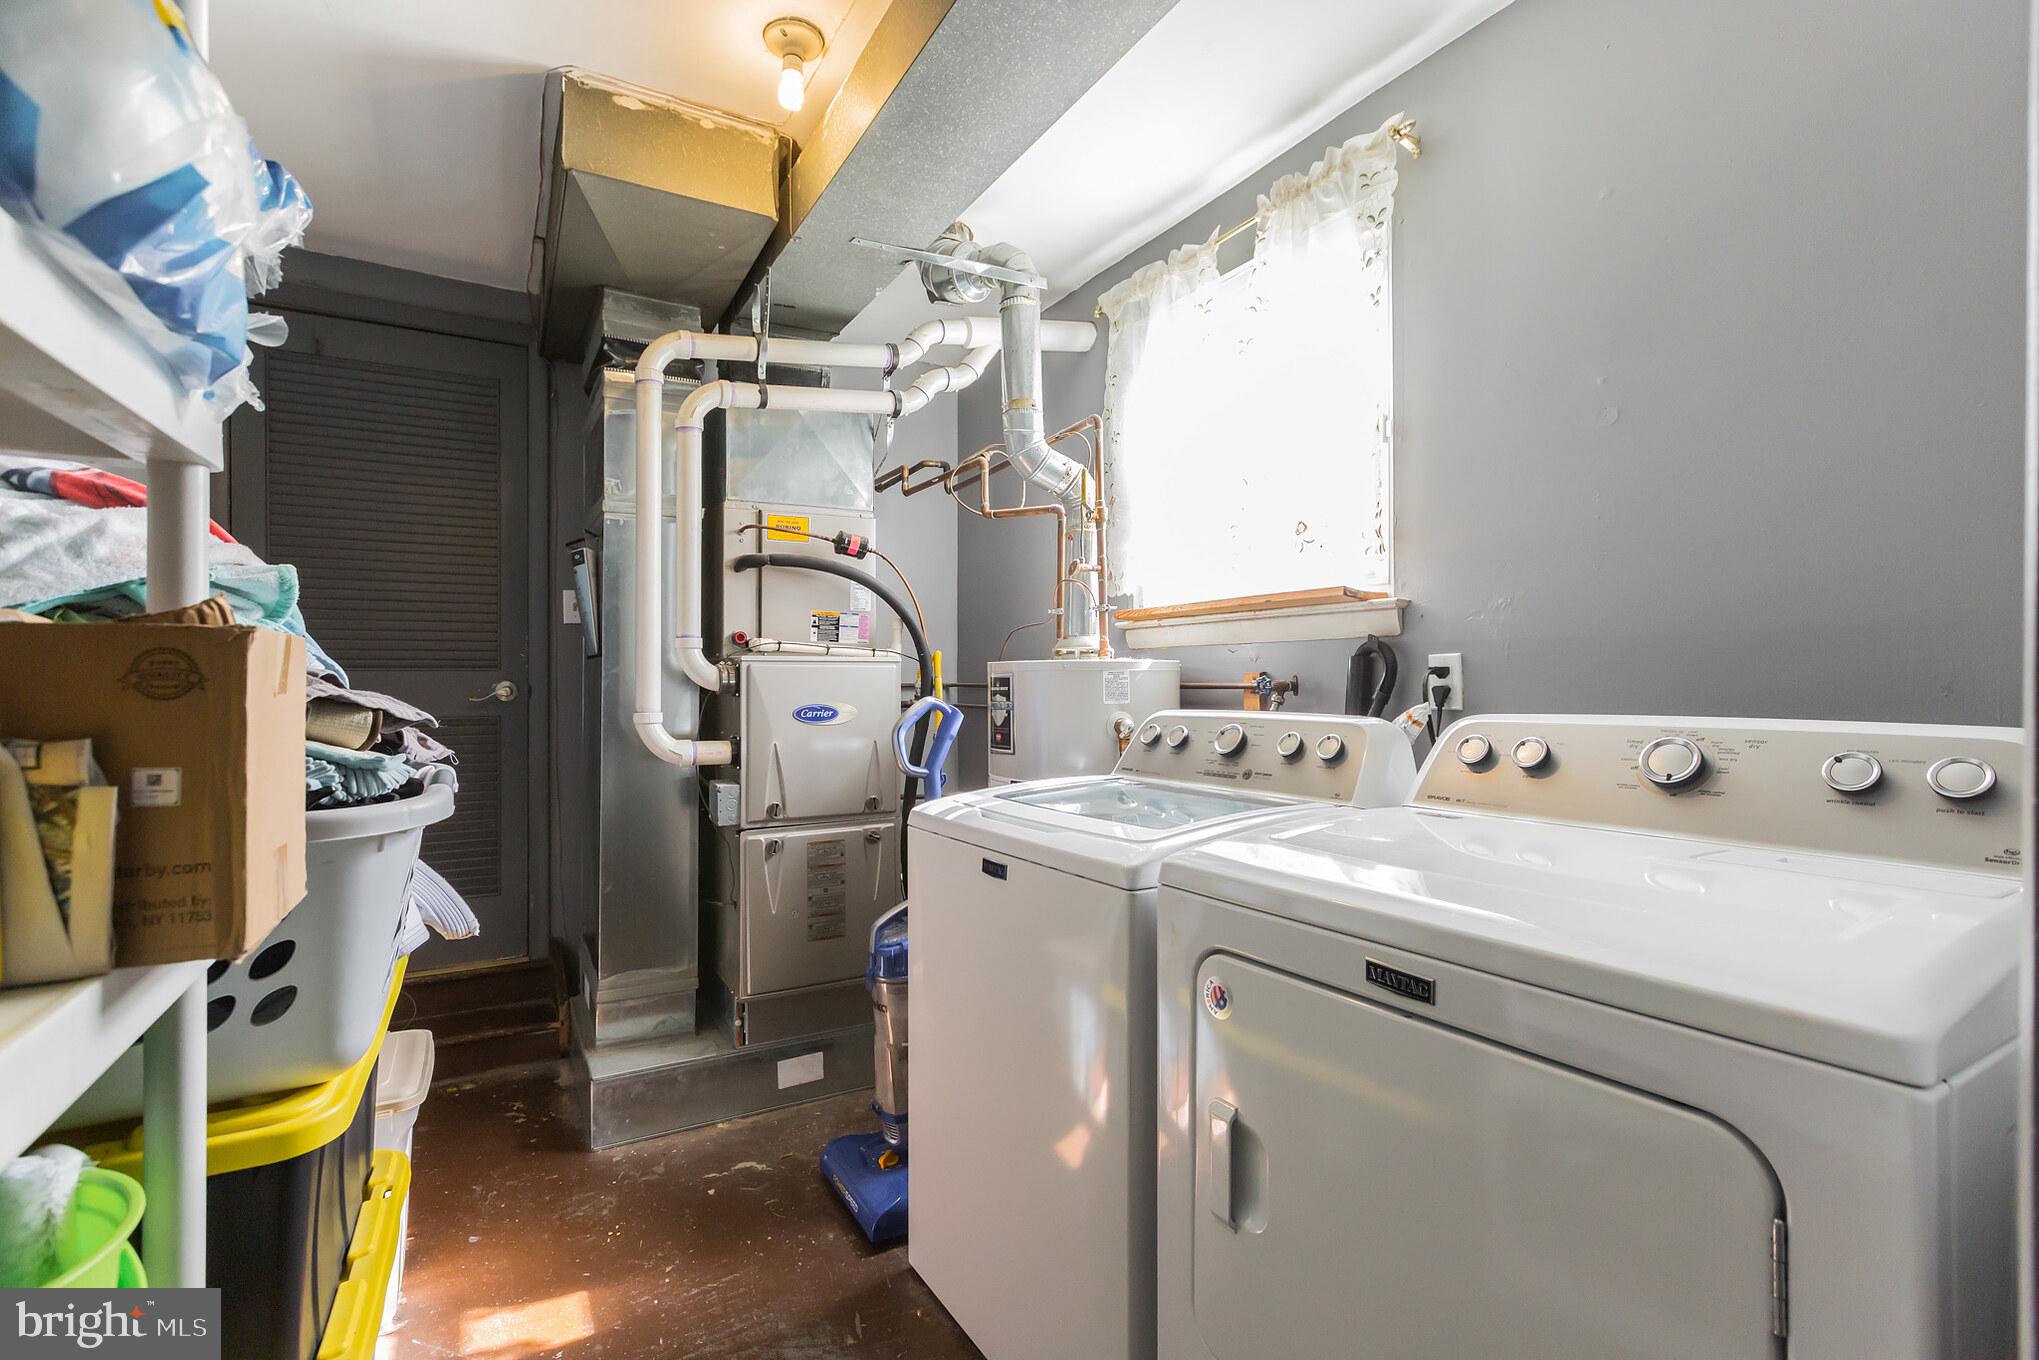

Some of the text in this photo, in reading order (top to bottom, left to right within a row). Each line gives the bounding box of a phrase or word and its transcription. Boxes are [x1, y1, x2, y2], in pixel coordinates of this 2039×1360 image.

[800, 709, 834, 718] Carrier
[1935, 807, 1955, 815] push
[1368, 965, 1430, 998] MAYTAG
